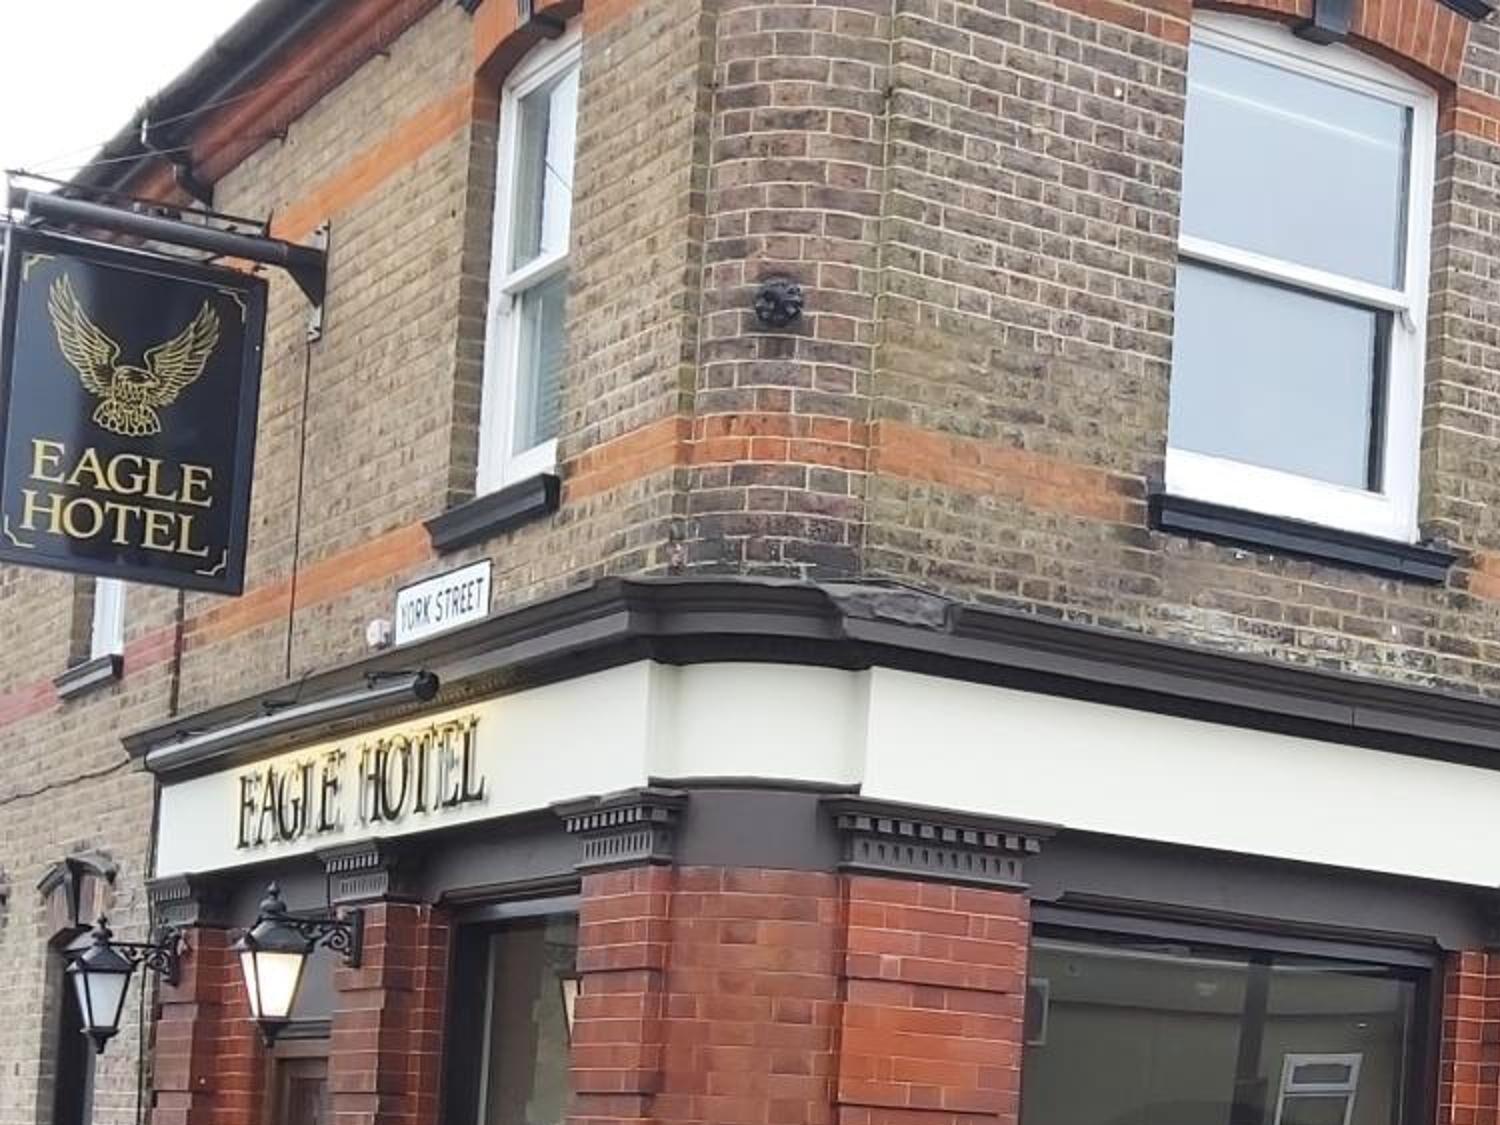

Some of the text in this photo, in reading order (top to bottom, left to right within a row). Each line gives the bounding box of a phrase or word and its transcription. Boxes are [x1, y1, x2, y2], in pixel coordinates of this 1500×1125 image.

[30, 438, 214, 507] EAGLE
[19, 490, 210, 557] HOTEL
[401, 577, 484, 632] YORK STREET
[237, 713, 488, 849] EAGLE HOTEL
